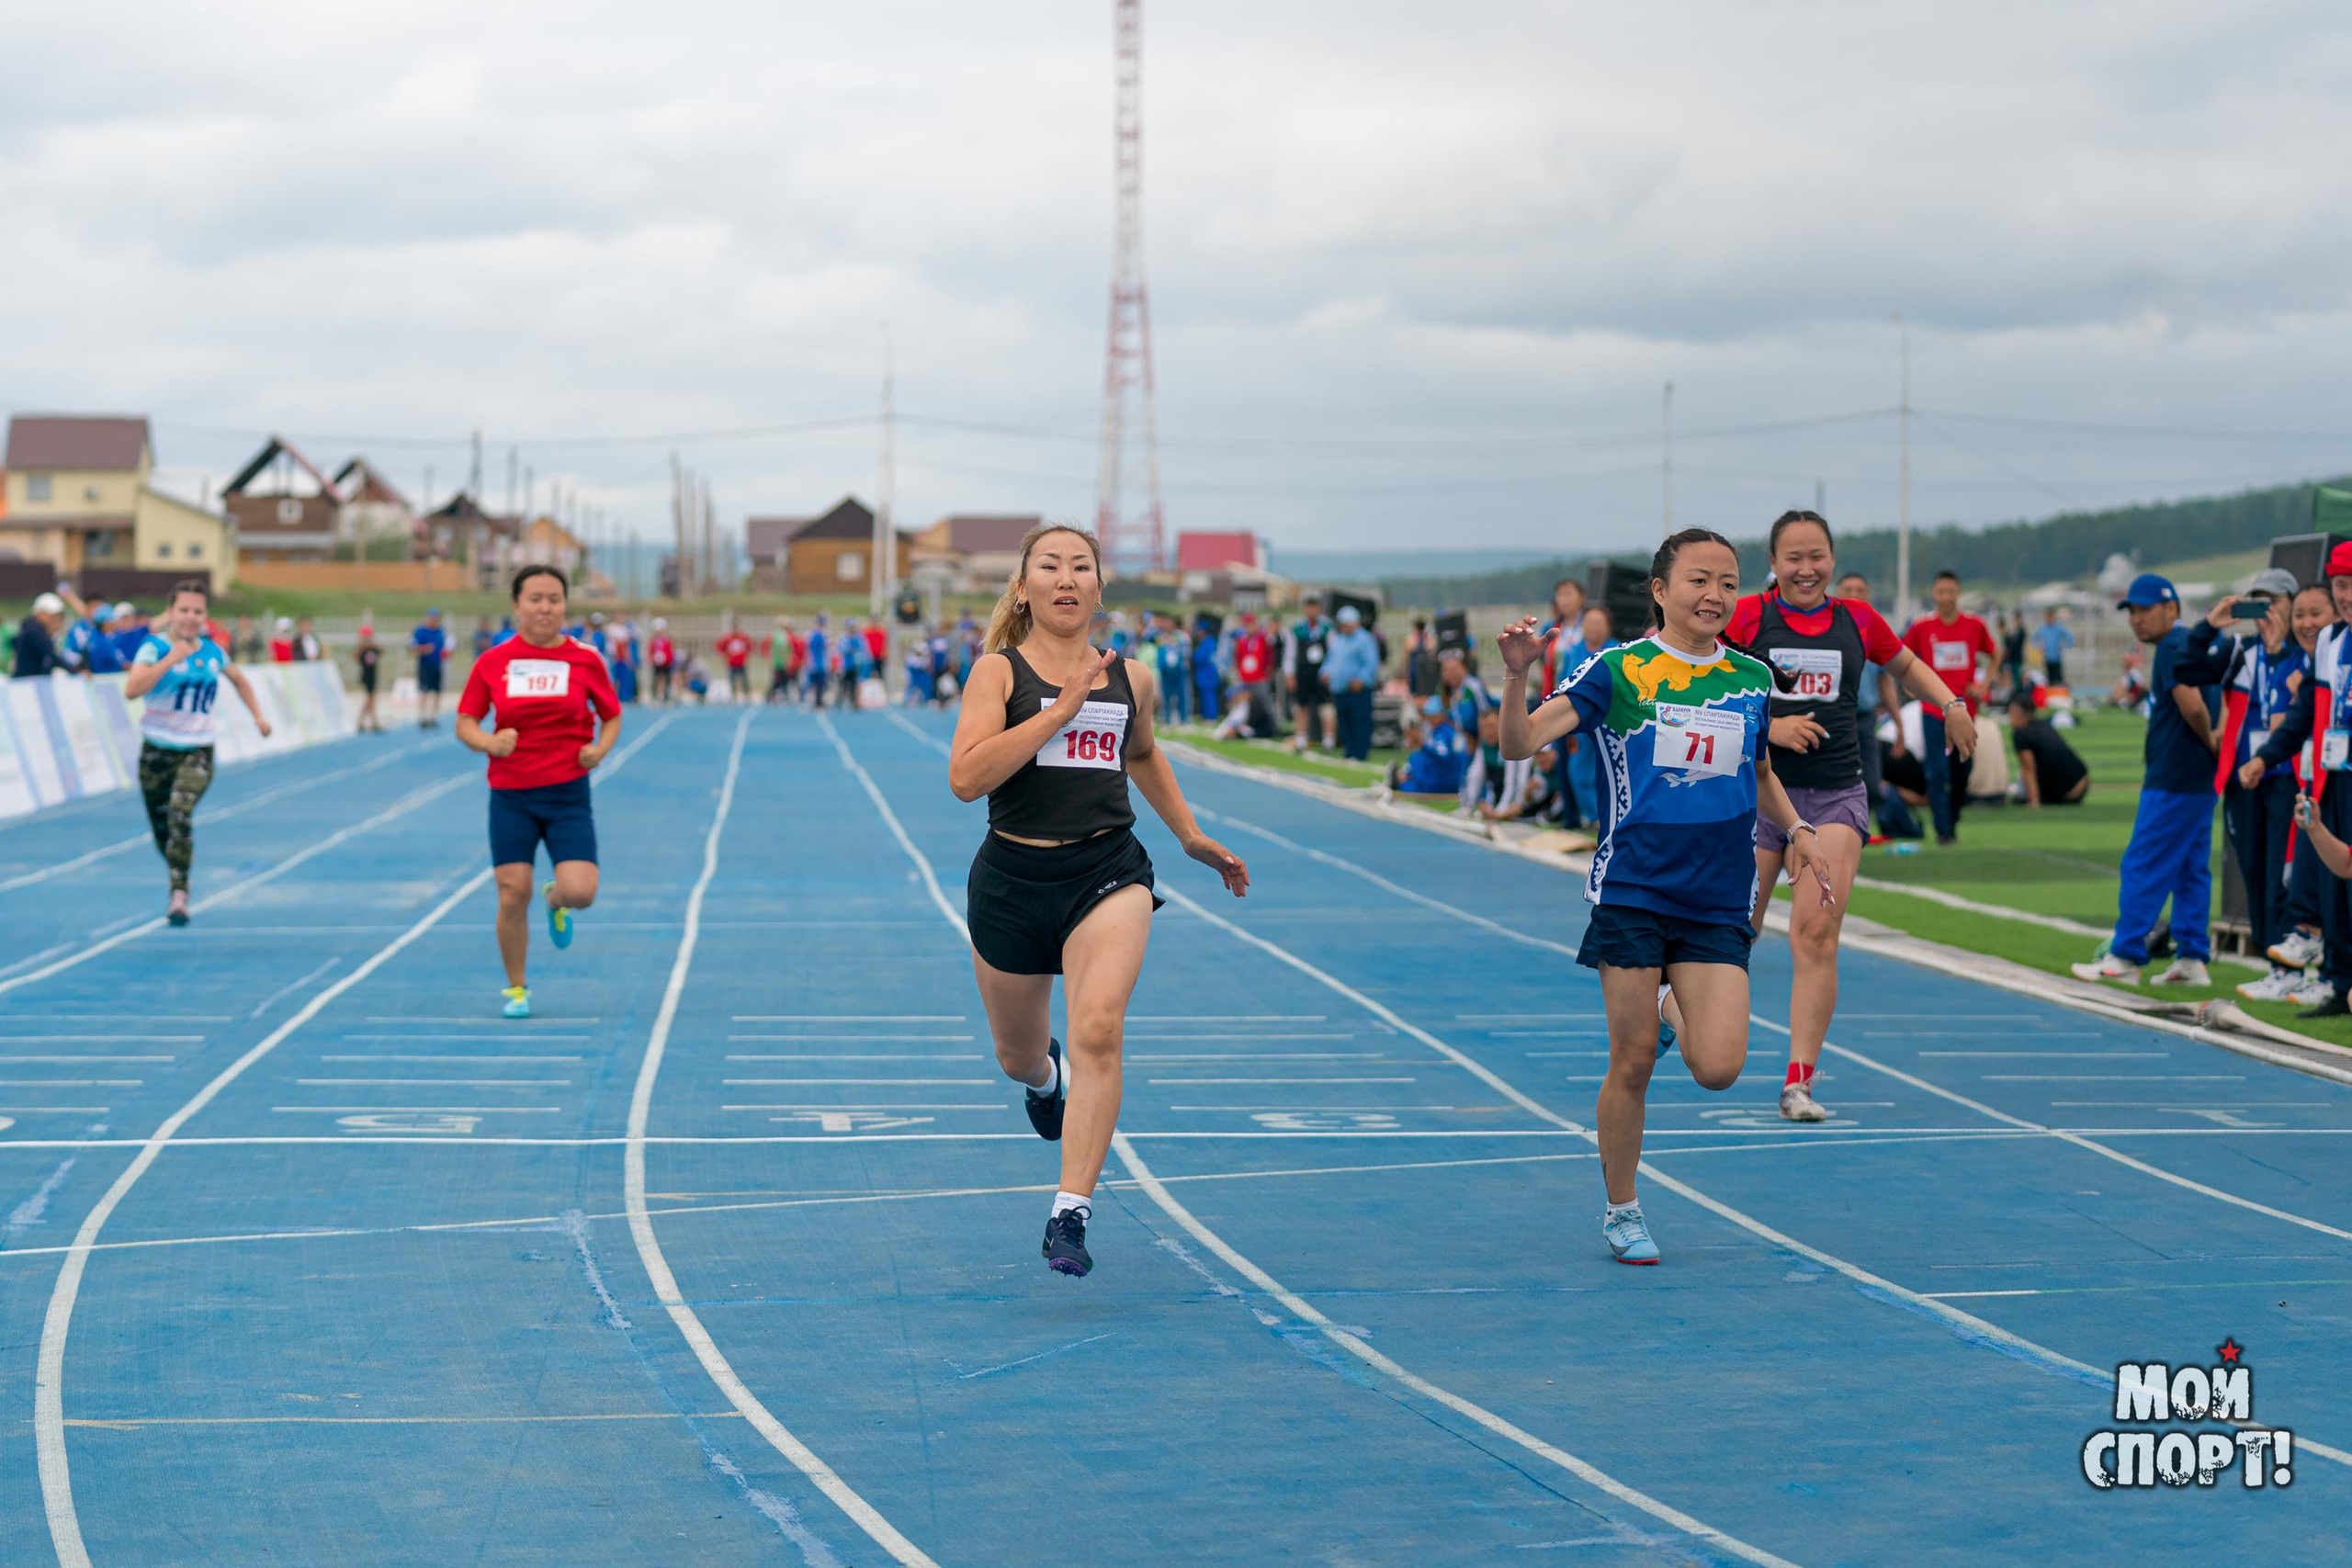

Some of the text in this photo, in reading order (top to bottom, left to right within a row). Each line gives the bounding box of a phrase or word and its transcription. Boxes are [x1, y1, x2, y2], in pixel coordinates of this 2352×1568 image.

[528, 674, 558, 691] 197
[1786, 671, 1832, 695] 03
[1088, 707, 1124, 716] СПАРТАКИАДА
[1703, 711, 1740, 721] СПАРТАКИАДА
[1064, 730, 1116, 761] 169
[1685, 731, 1714, 764] 71
